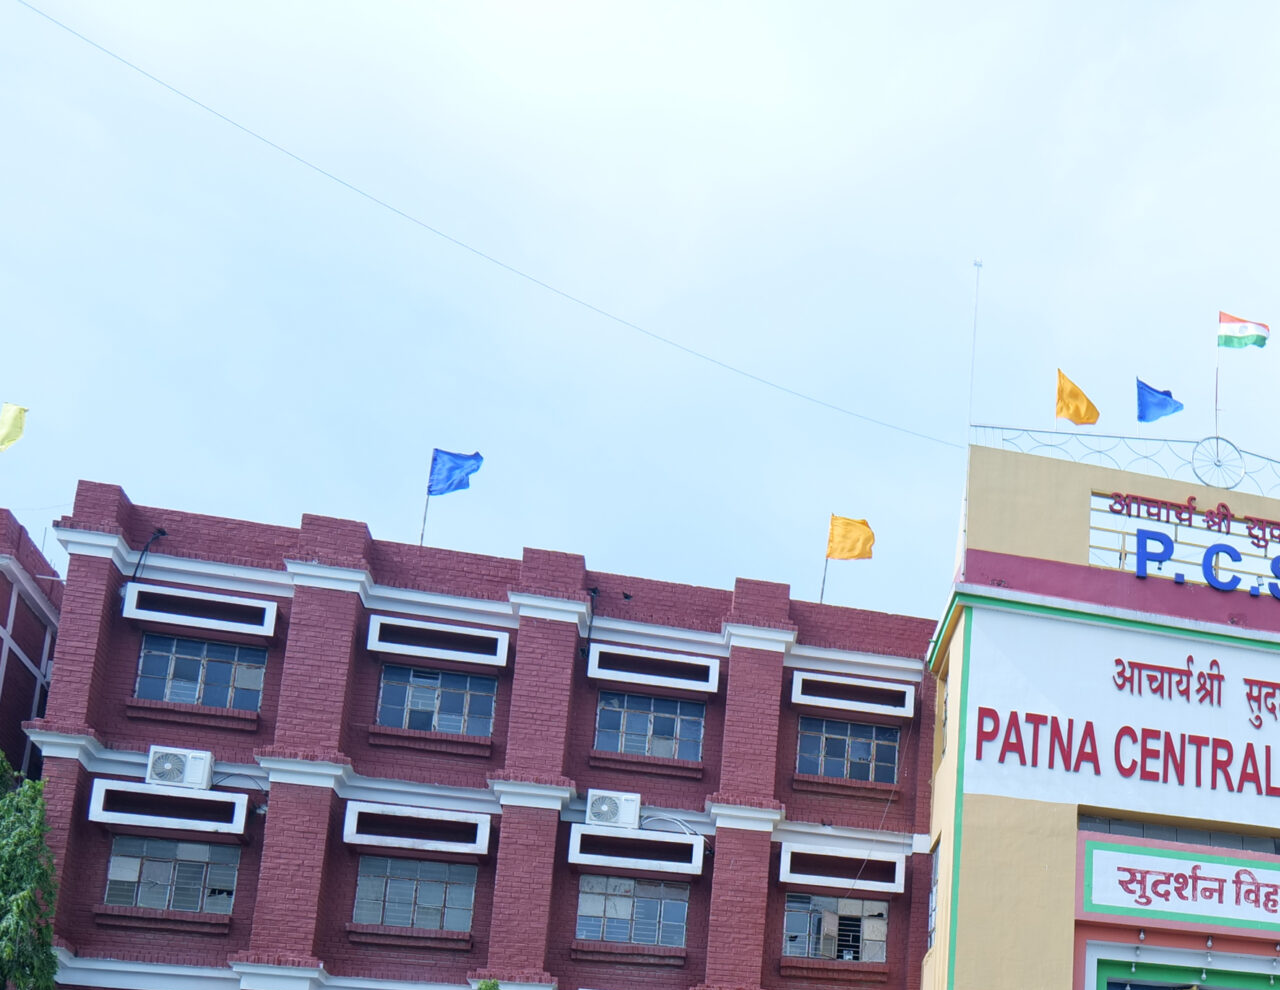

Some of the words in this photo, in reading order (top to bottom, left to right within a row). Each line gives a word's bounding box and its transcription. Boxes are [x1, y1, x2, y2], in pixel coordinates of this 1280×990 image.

[1109, 492, 1197, 527] आचार्य
[1203, 503, 1235, 534] श्री
[975, 706, 1101, 775] PATNA
[1117, 865, 1227, 906] सुदर्शन
